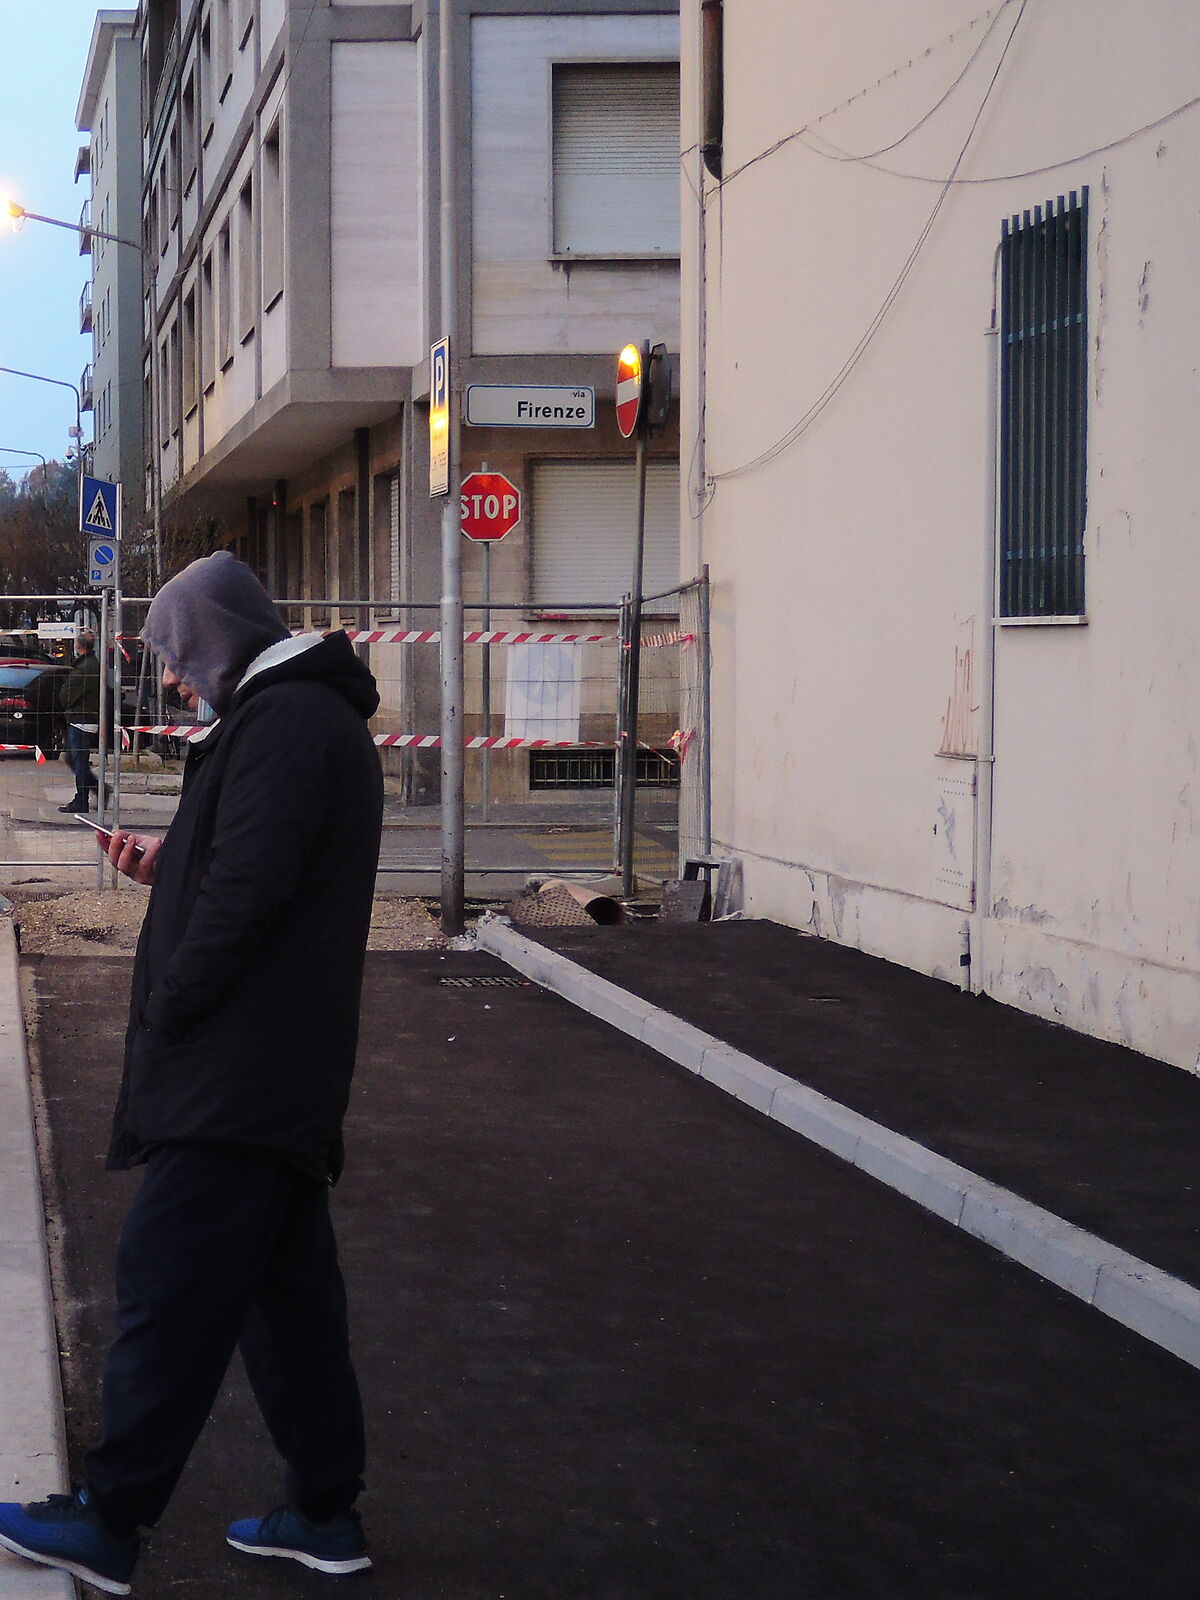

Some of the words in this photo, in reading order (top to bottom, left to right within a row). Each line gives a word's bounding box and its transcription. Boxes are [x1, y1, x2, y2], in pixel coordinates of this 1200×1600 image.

[435, 355, 444, 409] P
[572, 390, 586, 398] via
[517, 401, 586, 419] Firenze
[460, 494, 517, 520] STOP
